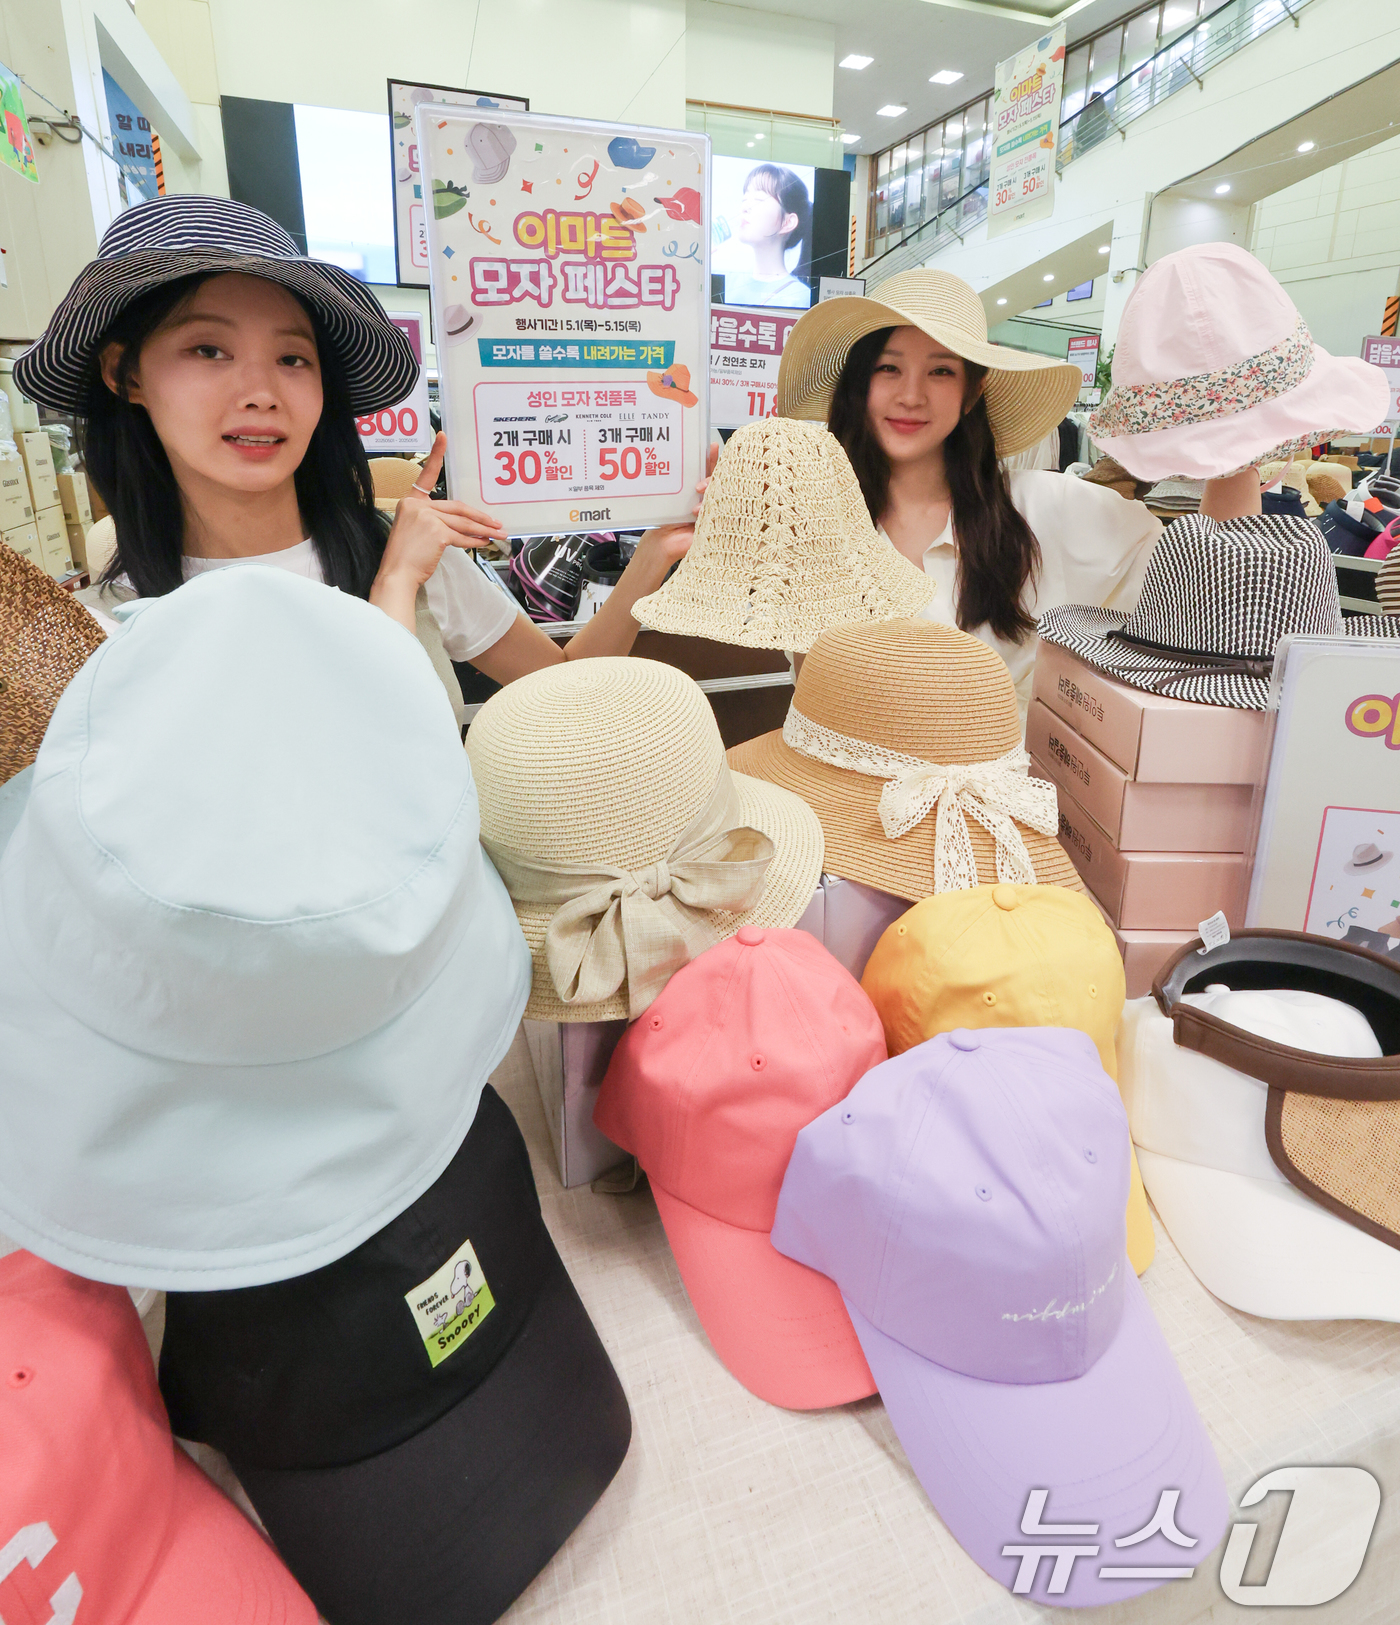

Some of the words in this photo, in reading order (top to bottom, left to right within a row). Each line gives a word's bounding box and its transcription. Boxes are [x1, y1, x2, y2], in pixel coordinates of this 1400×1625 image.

[1010, 72, 1043, 102] 이마트
[998, 102, 1019, 131] 모자
[1019, 83, 1056, 117] 페스타
[116, 113, 133, 131] 할
[513, 209, 637, 262] 이마트
[469, 257, 557, 308] 모자
[561, 260, 680, 311] 페스타
[515, 318, 558, 331] 행사기간
[492, 345, 535, 361] 모자를
[539, 345, 580, 361] 쓸수록
[583, 345, 636, 361] 내려가는
[639, 346, 665, 365] 가격
[722, 355, 748, 368] 천연초
[749, 358, 766, 370] 모자
[721, 378, 735, 386] 30%
[527, 391, 557, 408] 성인
[561, 391, 590, 408] 모자
[594, 390, 637, 407] 전품목
[619, 412, 635, 420] ELLE
[493, 430, 519, 446] 2개
[522, 429, 553, 446] 구매
[556, 428, 571, 445] 시
[598, 427, 622, 443] 3개
[625, 426, 653, 443] 구매
[656, 426, 669, 442] 시
[544, 465, 573, 481] 할인
[644, 461, 670, 476] 할인
[569, 507, 611, 523] emart
[416, 1292, 439, 1311] FRIENDS
[425, 1295, 449, 1315] FOREVER
